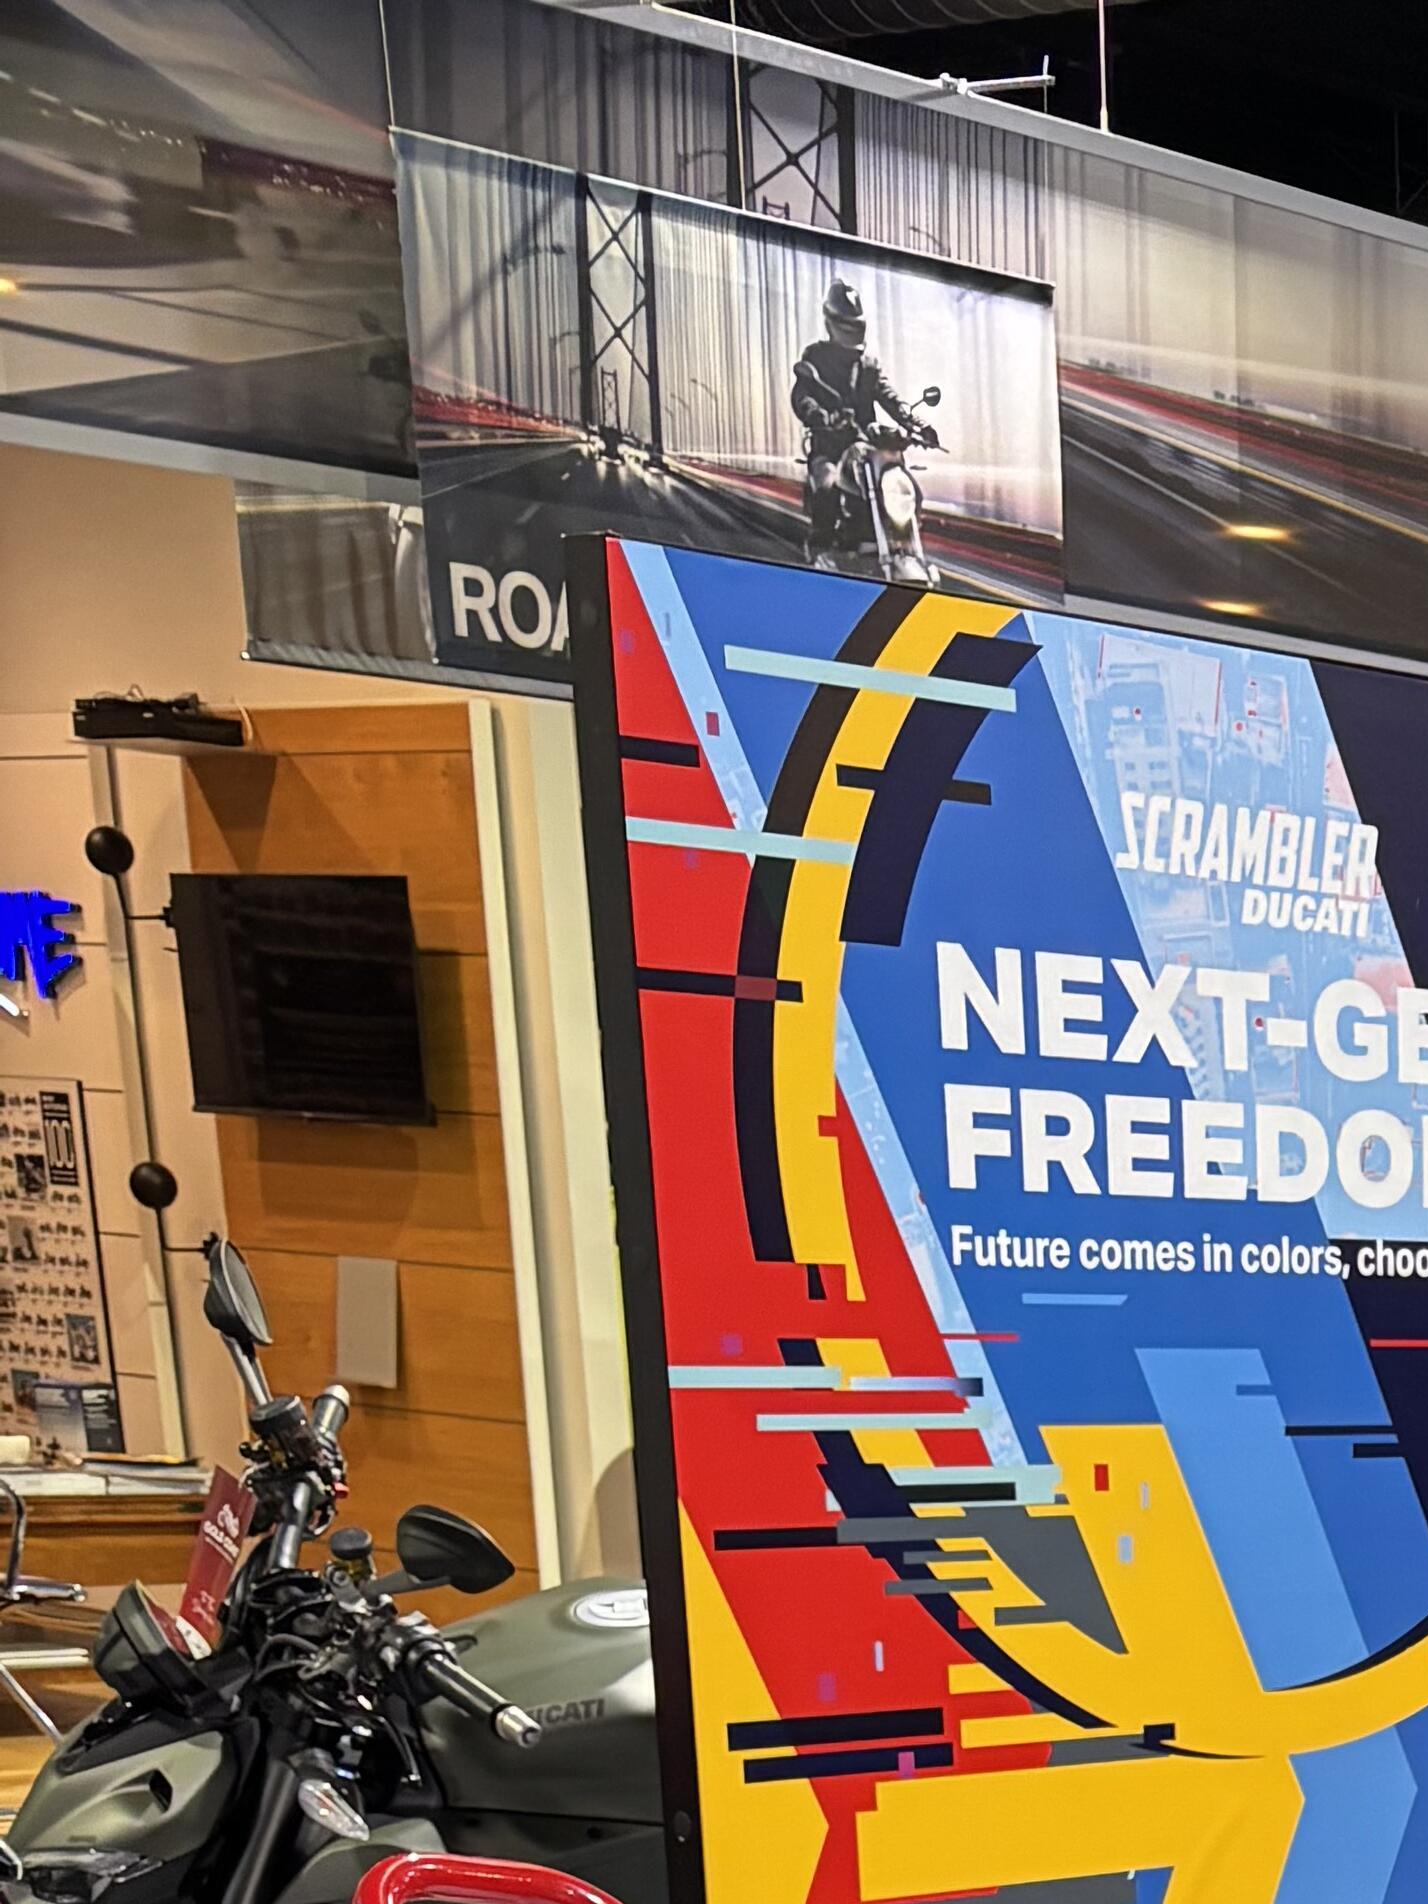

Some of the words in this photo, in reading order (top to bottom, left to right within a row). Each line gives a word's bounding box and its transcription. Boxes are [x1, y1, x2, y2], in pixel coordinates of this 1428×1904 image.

[1117, 791, 1379, 894] SCRAMBLER
[1241, 888, 1370, 937] DUCATI
[951, 1225, 1071, 1270] Future
[1079, 1236, 1195, 1272] comes
[1203, 1233, 1230, 1272] in
[1240, 1236, 1351, 1280] colors,
[527, 1698, 605, 1724] UCATI
